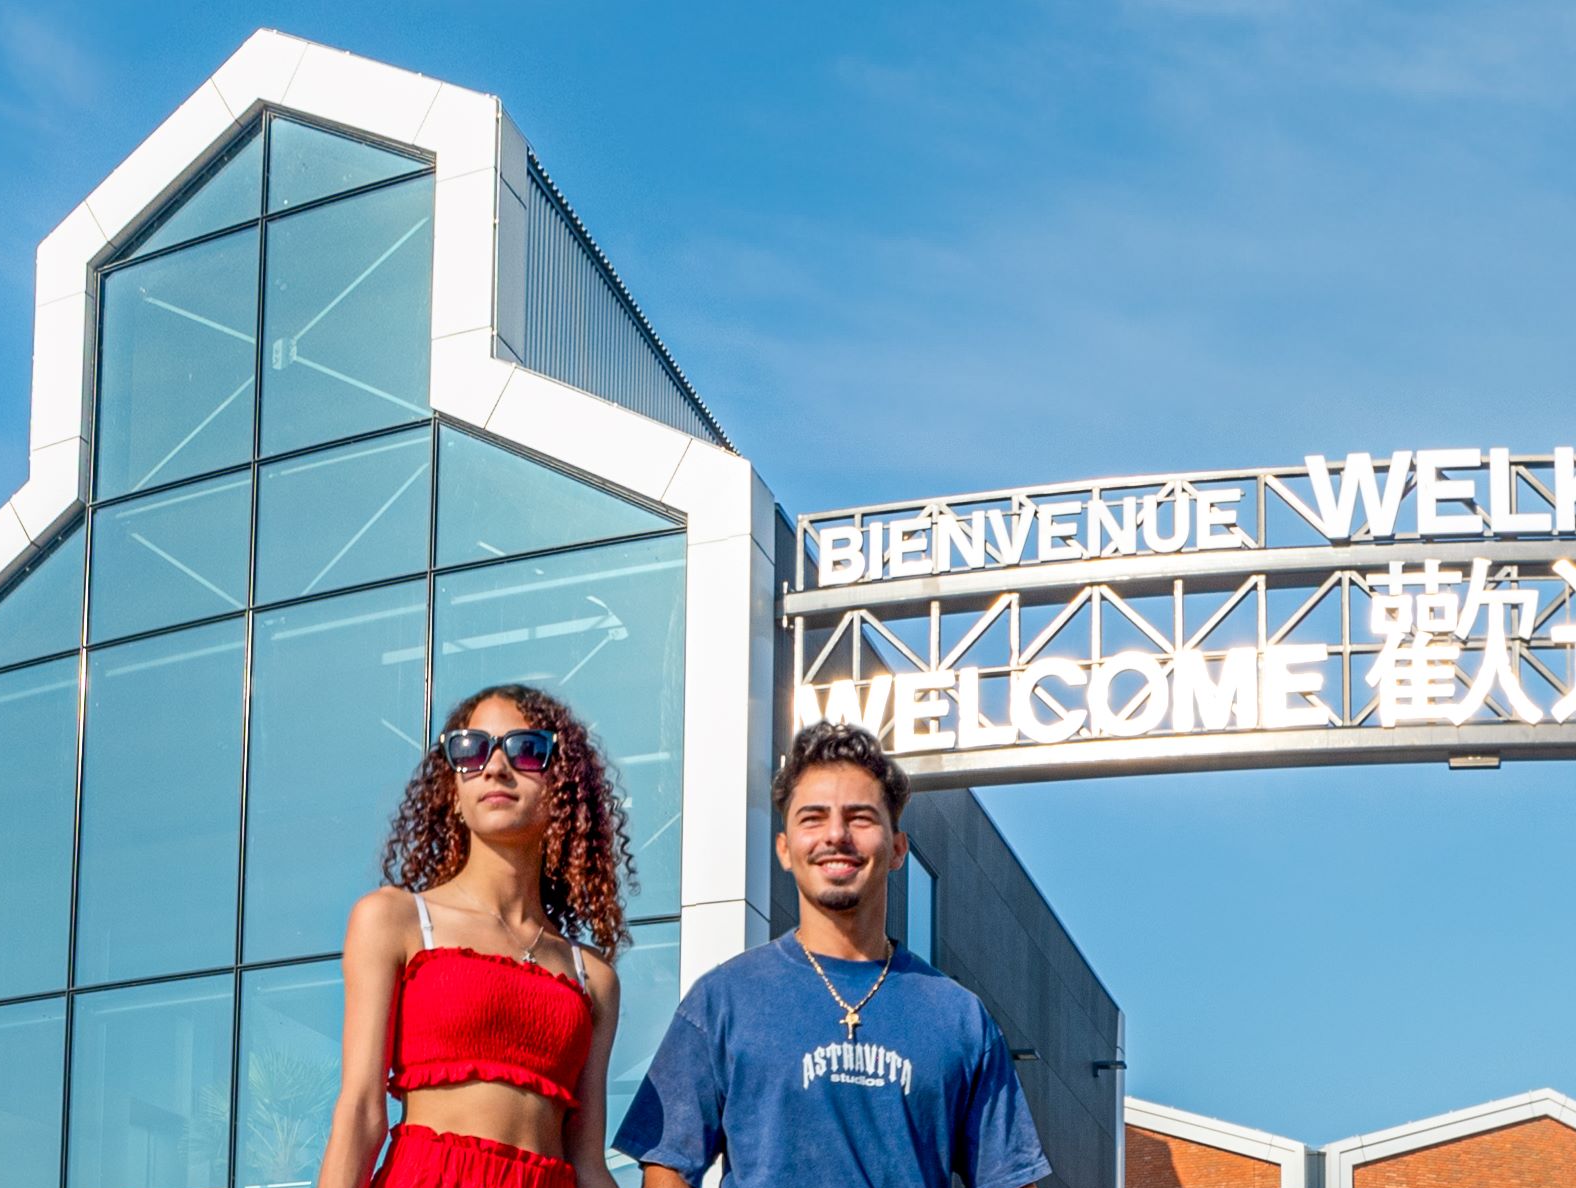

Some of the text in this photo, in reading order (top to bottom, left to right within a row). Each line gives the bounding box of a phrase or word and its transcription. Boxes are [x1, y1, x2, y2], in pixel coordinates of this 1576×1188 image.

[818, 488, 1244, 587] BIENVENUE
[795, 644, 1328, 753] WELCOME
[803, 1041, 912, 1095] ASTRAVITA
[830, 1073, 885, 1086] studios
